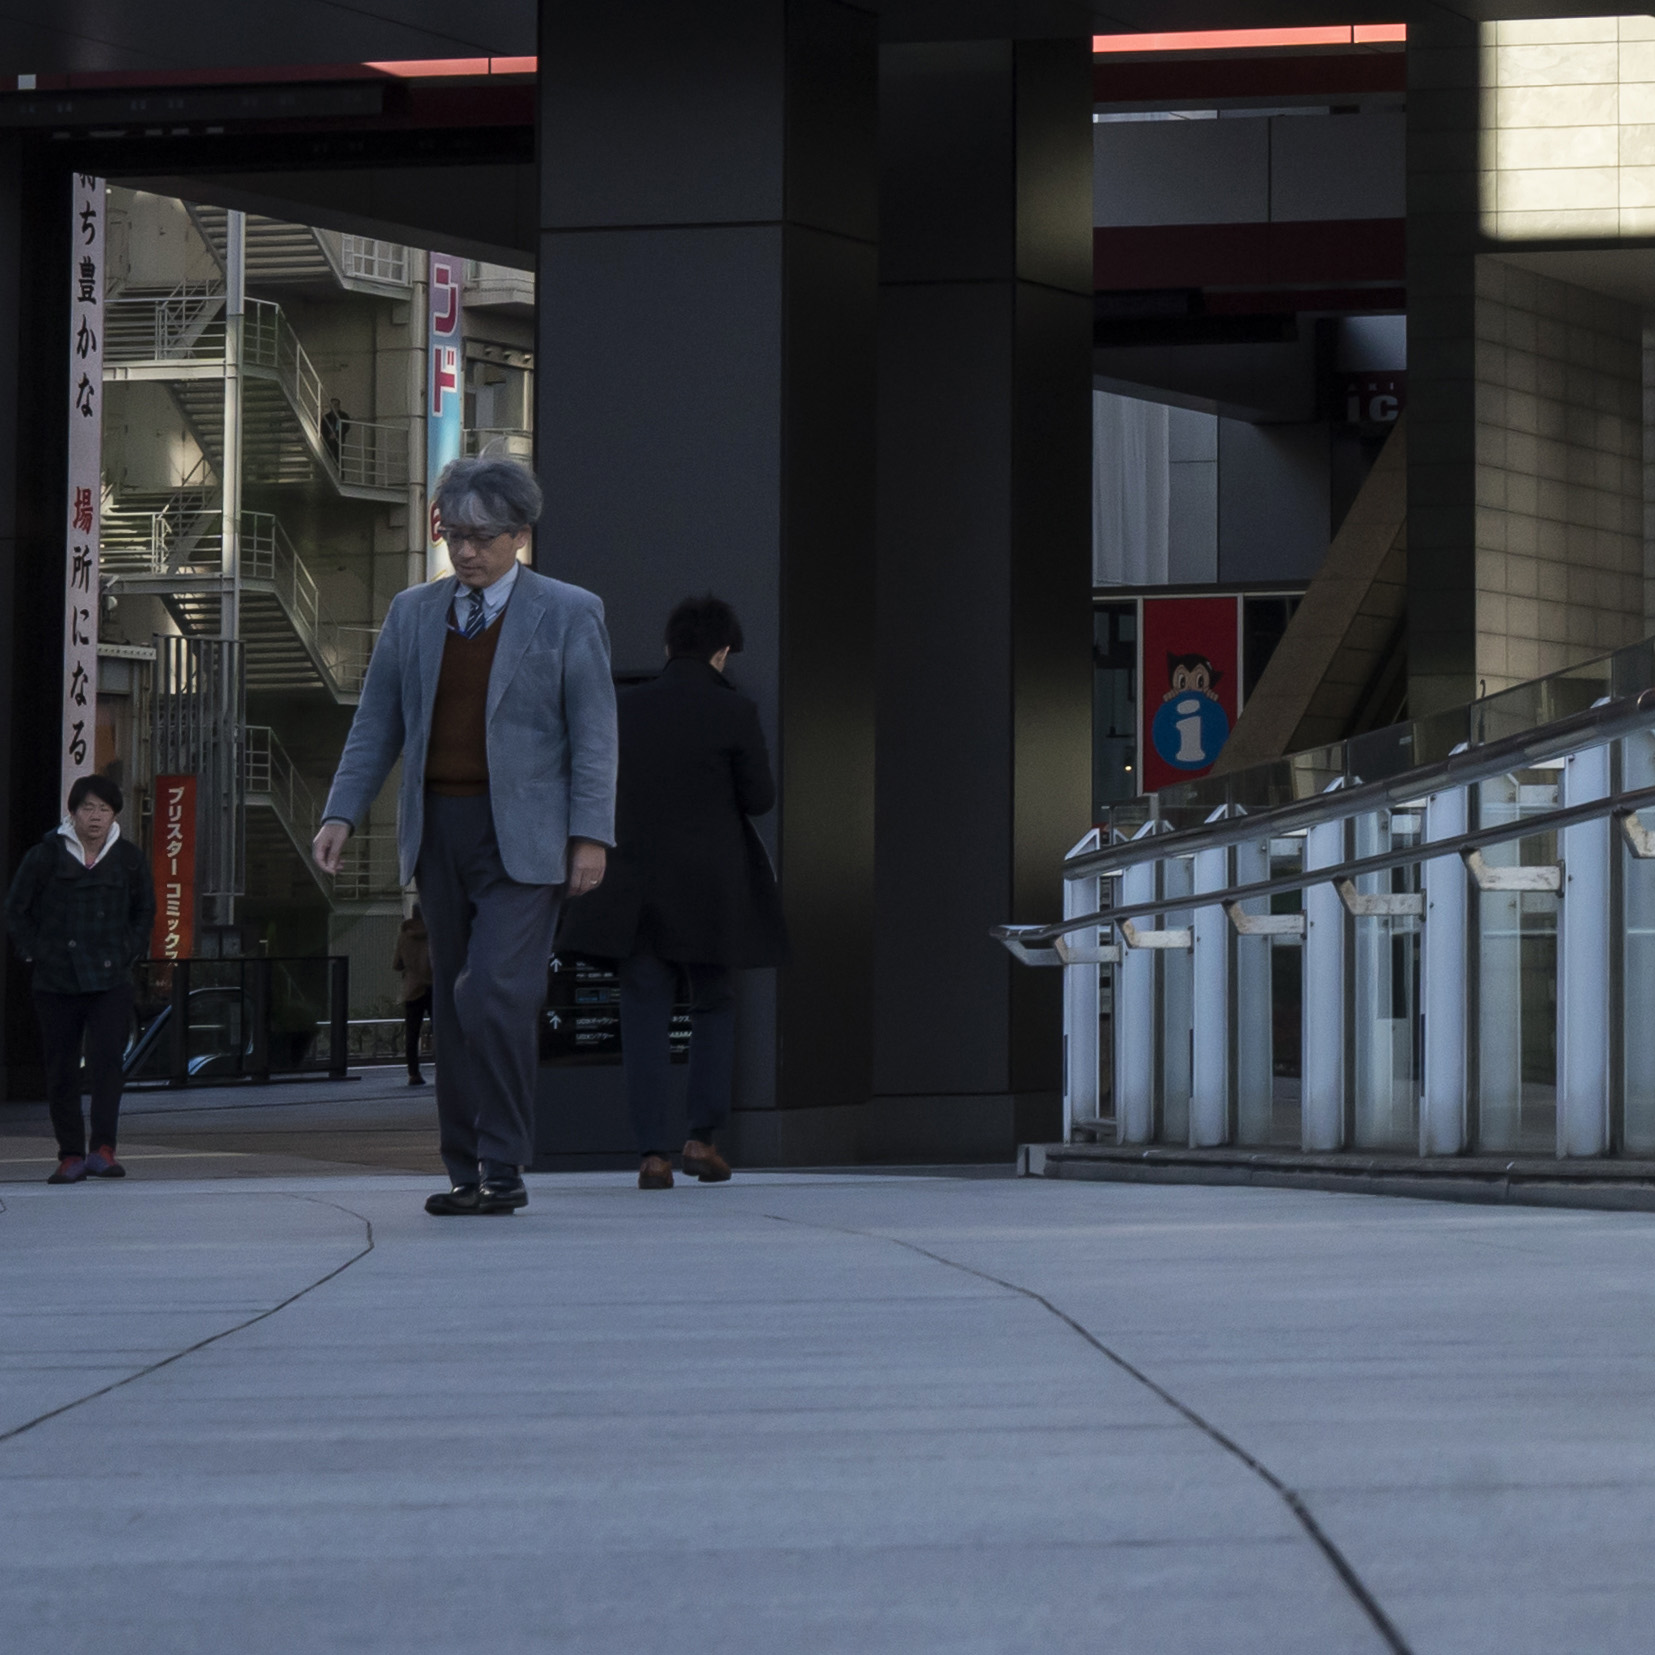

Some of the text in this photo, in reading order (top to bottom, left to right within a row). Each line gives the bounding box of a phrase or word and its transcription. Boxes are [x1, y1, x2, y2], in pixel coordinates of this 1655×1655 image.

[68, 487, 93, 765] 場所になる
